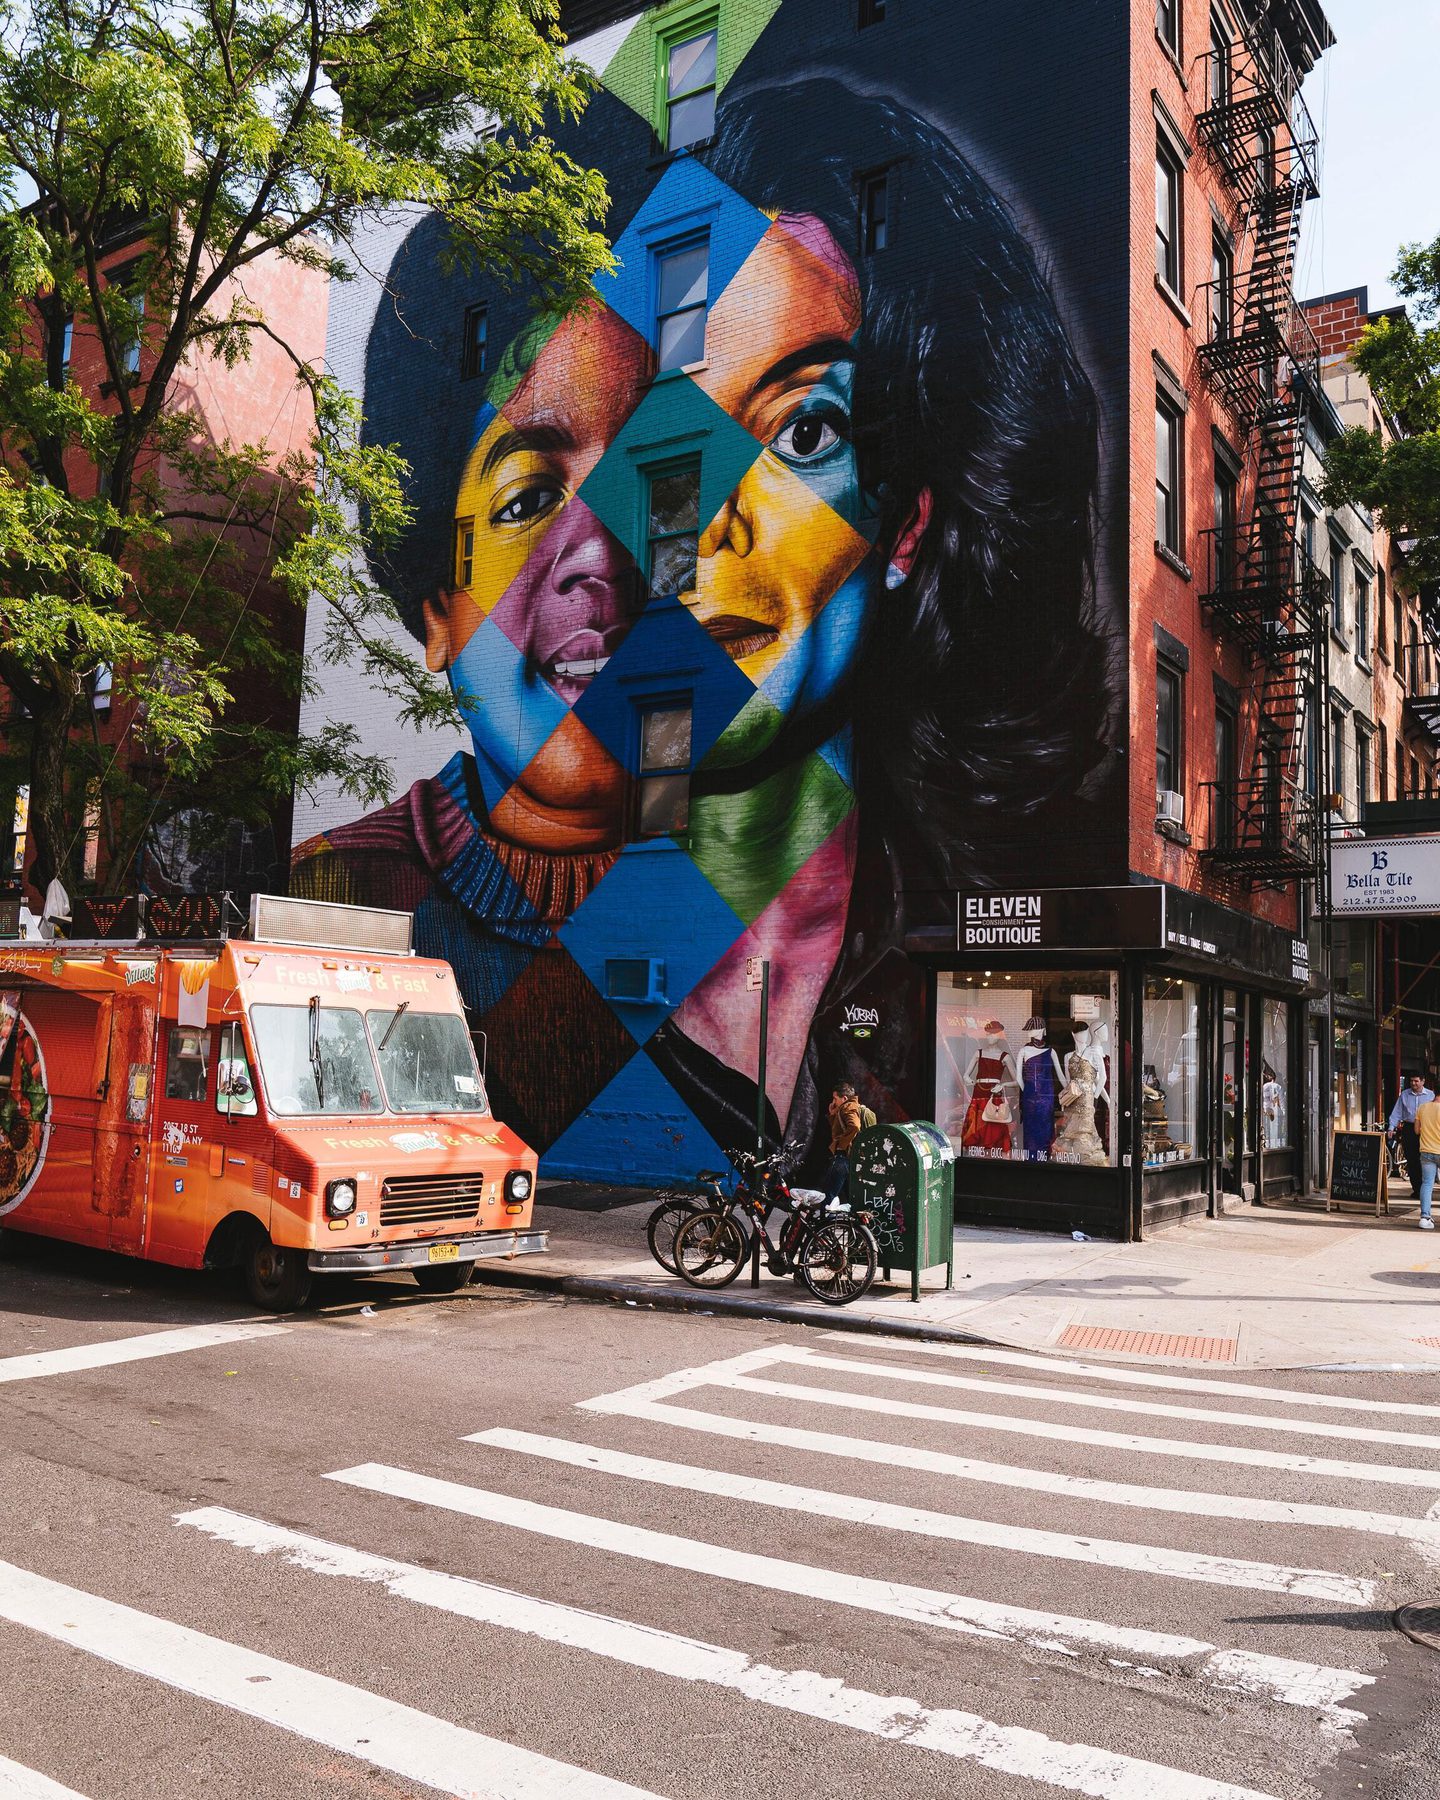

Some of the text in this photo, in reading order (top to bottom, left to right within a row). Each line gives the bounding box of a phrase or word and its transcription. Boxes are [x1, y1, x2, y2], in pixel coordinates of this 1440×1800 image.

[1345, 872, 1413, 890] Bella Tile
[966, 896, 1041, 918] ELEVEN
[1342, 895, 1417, 905] 212.475.2909
[982, 918, 1024, 926] CONSIGNMENT
[965, 927, 1041, 944] BOUTIQUE
[1292, 940, 1308, 960] ELEVEN
[125, 965, 156, 985] Village
[275, 966, 330, 986] Fresh
[376, 973, 388, 991] &
[392, 975, 429, 993] Fast
[1292, 964, 1309, 981] BOUTIQUE
[844, 1004, 879, 1024] KOBRA
[181, 1123, 188, 1133] 18
[189, 1124, 199, 1134] ST
[192, 1135, 203, 1145] NY
[323, 1137, 388, 1150] Fresh
[444, 1134, 462, 1147] &
[460, 1132, 504, 1145] Fast
[968, 1146, 985, 1157] HERMES
[990, 1147, 1003, 1159] GUCC
[1037, 1150, 1047, 1162] D&G
[1341, 1166, 1368, 1180] SALE
